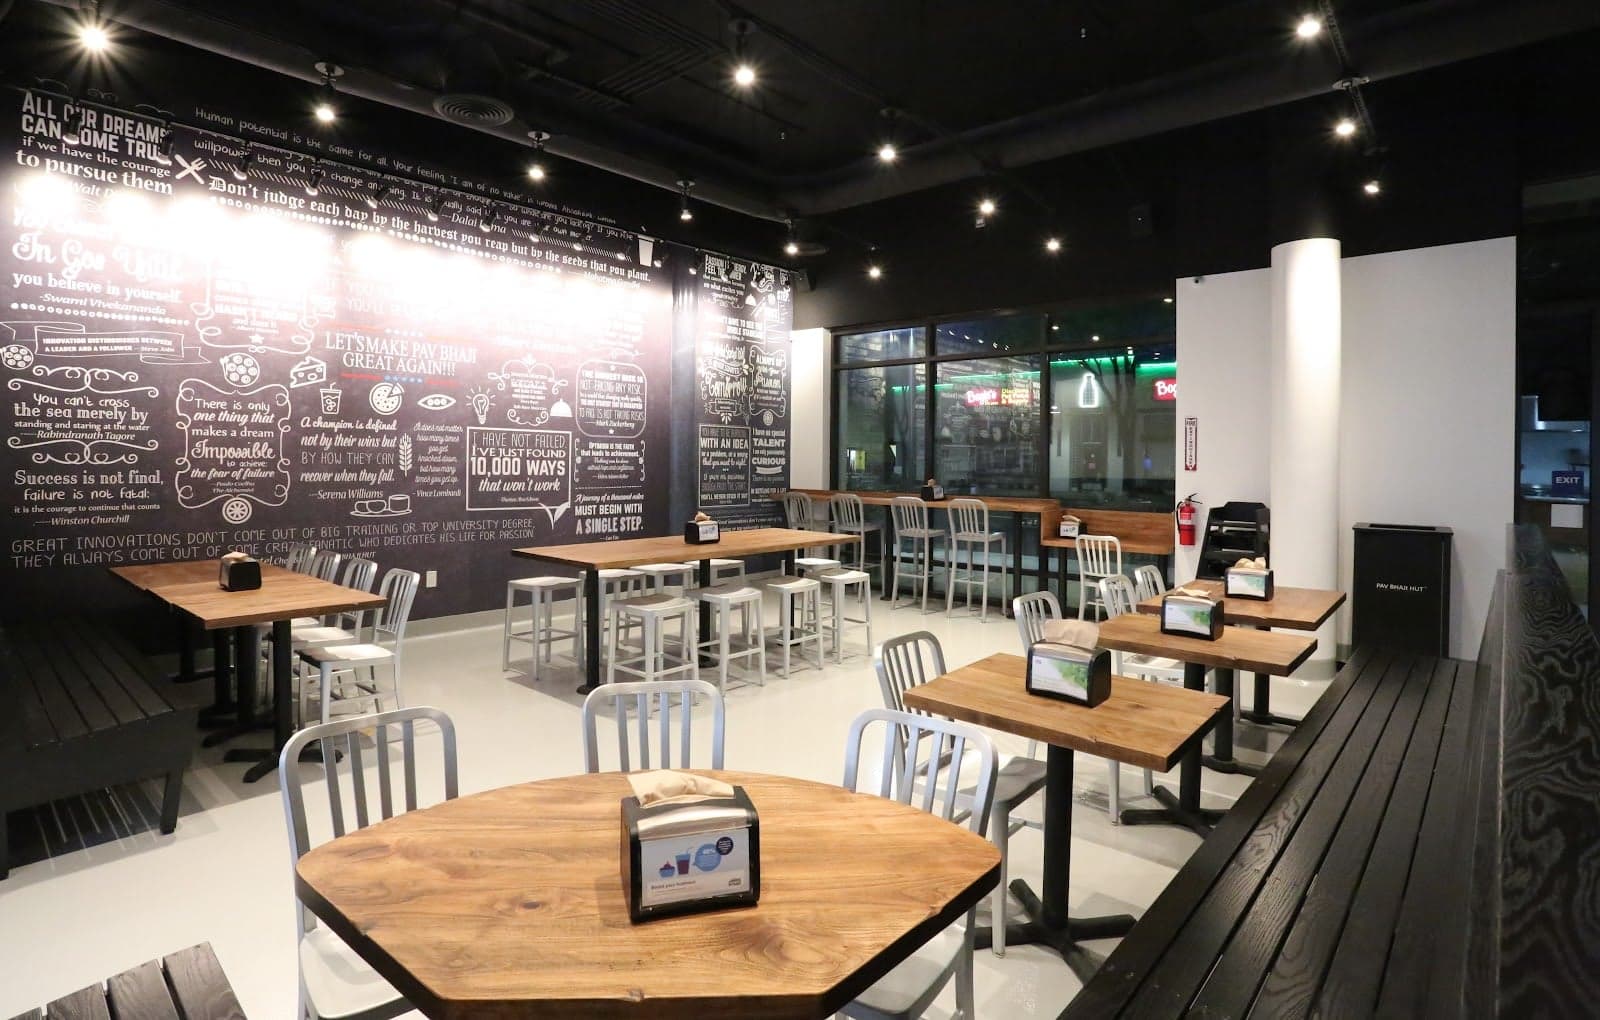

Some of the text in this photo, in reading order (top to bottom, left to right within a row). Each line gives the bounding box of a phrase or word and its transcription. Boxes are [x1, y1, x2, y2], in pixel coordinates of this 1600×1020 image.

[22, 92, 56, 119] ALL
[22, 114, 161, 161] CAN OME TRU
[23, 136, 171, 178] if we have the courage
[16, 150, 39, 167] to
[45, 157, 117, 183] pursue
[122, 172, 172, 195] them
[209, 176, 258, 199] Don't
[264, 189, 305, 210] judge
[310, 197, 340, 217] each
[345, 203, 368, 223] day
[373, 212, 387, 229] by
[392, 213, 410, 231] the
[414, 221, 464, 241] harvest
[461, 229, 481, 246] you
[485, 237, 508, 252] reap
[512, 242, 529, 256] but
[531, 246, 543, 260] by
[546, 247, 560, 262] the
[562, 254, 587, 268] seeds
[591, 259, 607, 273] that
[609, 263, 625, 277] you
[627, 268, 651, 282] plant.
[13, 273, 42, 288] you
[47, 273, 102, 293] believe
[106, 280, 120, 296] in
[325, 331, 477, 363] LET'S MAKE PAV BHAJI
[342, 352, 457, 376] GREAT AGAIN!!!
[64, 395, 94, 406] can't
[98, 399, 130, 408] cross
[194, 398, 270, 415] There is only
[14, 402, 148, 425] the sea merely by
[194, 411, 275, 426] one thing that
[14, 420, 52, 430] standing
[55, 421, 70, 429] and
[73, 422, 102, 431] staring
[114, 422, 127, 431] the
[192, 425, 274, 437] makes a dream
[301, 417, 398, 432] A champion is defined
[301, 435, 397, 451] not by their wins but
[473, 432, 567, 448] I HAVE NOT FAILED.
[701, 438, 749, 449] WITH AN IDEA
[752, 438, 786, 447] TALENT
[191, 439, 276, 464] Impossible
[302, 452, 394, 465] BY HOW THEY CAN
[472, 445, 566, 458] I'VE JUST FOUND
[470, 457, 520, 477] 10,000
[527, 460, 565, 476] WAYS
[752, 457, 786, 465] CURIOUS
[14, 469, 164, 485] Success is not final,
[190, 468, 276, 480] the fear of failure
[300, 468, 395, 485] recover when they fall.
[1555, 476, 1580, 484] EXIT
[479, 477, 560, 492] that won't work
[24, 488, 150, 501] failure is not fatal:
[32, 505, 44, 513] the
[46, 506, 77, 514] courage
[575, 504, 642, 516] MUST BEGIN WITH
[576, 516, 643, 534] A SINGLE STEP.
[12, 538, 68, 554] GREAT
[77, 533, 181, 550] INNOVATIONS
[187, 531, 228, 544] DON'T
[234, 529, 265, 542] COME
[272, 528, 297, 541] OUT
[302, 528, 315, 540] OF
[321, 526, 340, 538] BIG
[347, 524, 398, 537] TRAINING
[402, 522, 417, 534] OR
[422, 522, 439, 533] TOP
[442, 520, 498, 531] UNIVERSITY
[13, 554, 55, 569] THEY
[63, 550, 123, 566] ALWAYS
[130, 549, 166, 561] COME
[172, 546, 197, 559] OUT
[206, 545, 221, 557] OF
[359, 537, 380, 549] WHO
[383, 533, 436, 546] DEDICATES
[440, 530, 456, 543] HIS
[458, 529, 476, 542] LIFE
[479, 529, 495, 541] FOR
[499, 528, 534, 539] PASSION
